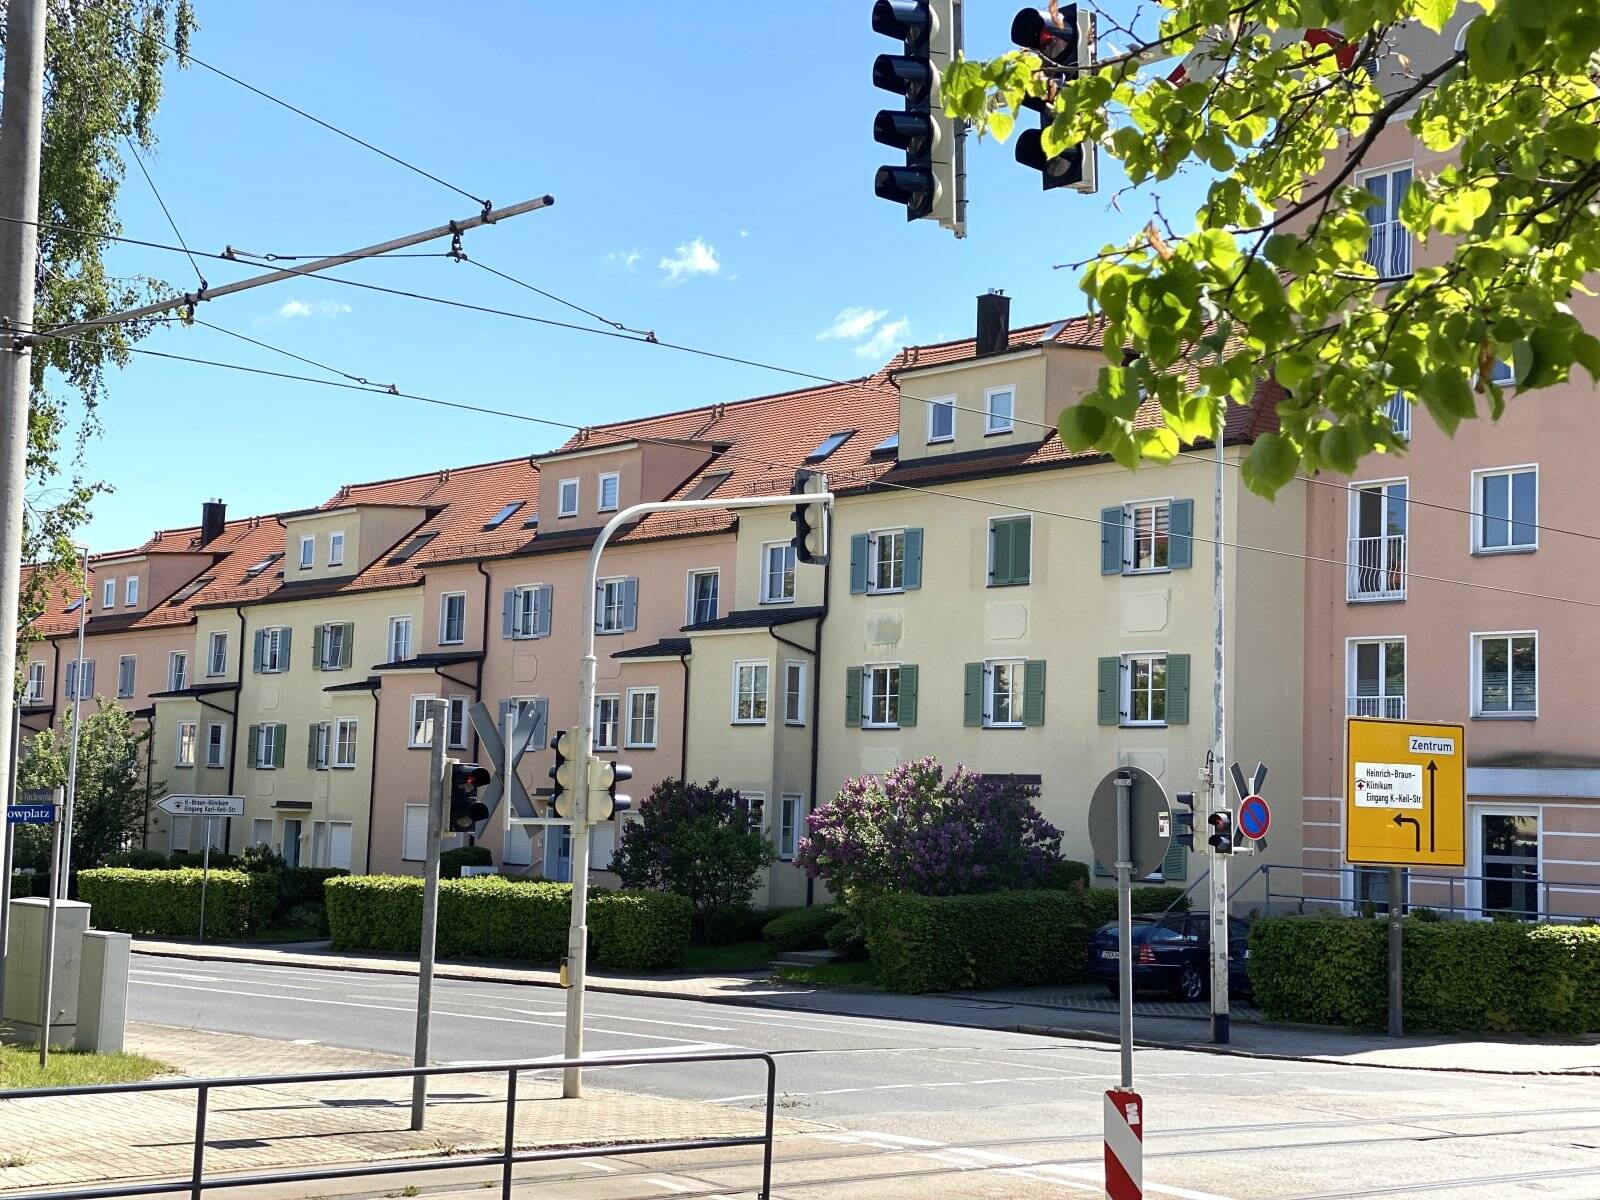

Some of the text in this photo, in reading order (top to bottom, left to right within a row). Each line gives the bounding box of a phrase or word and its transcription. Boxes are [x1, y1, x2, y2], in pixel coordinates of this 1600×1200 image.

[1411, 739, 1452, 752] Zentrum
[1366, 768, 1416, 779] Heinrich-Braun-
[1366, 780, 1393, 790] Klinikum
[1366, 792, 1389, 804] Eingang
[184, 805, 203, 813] Eingang
